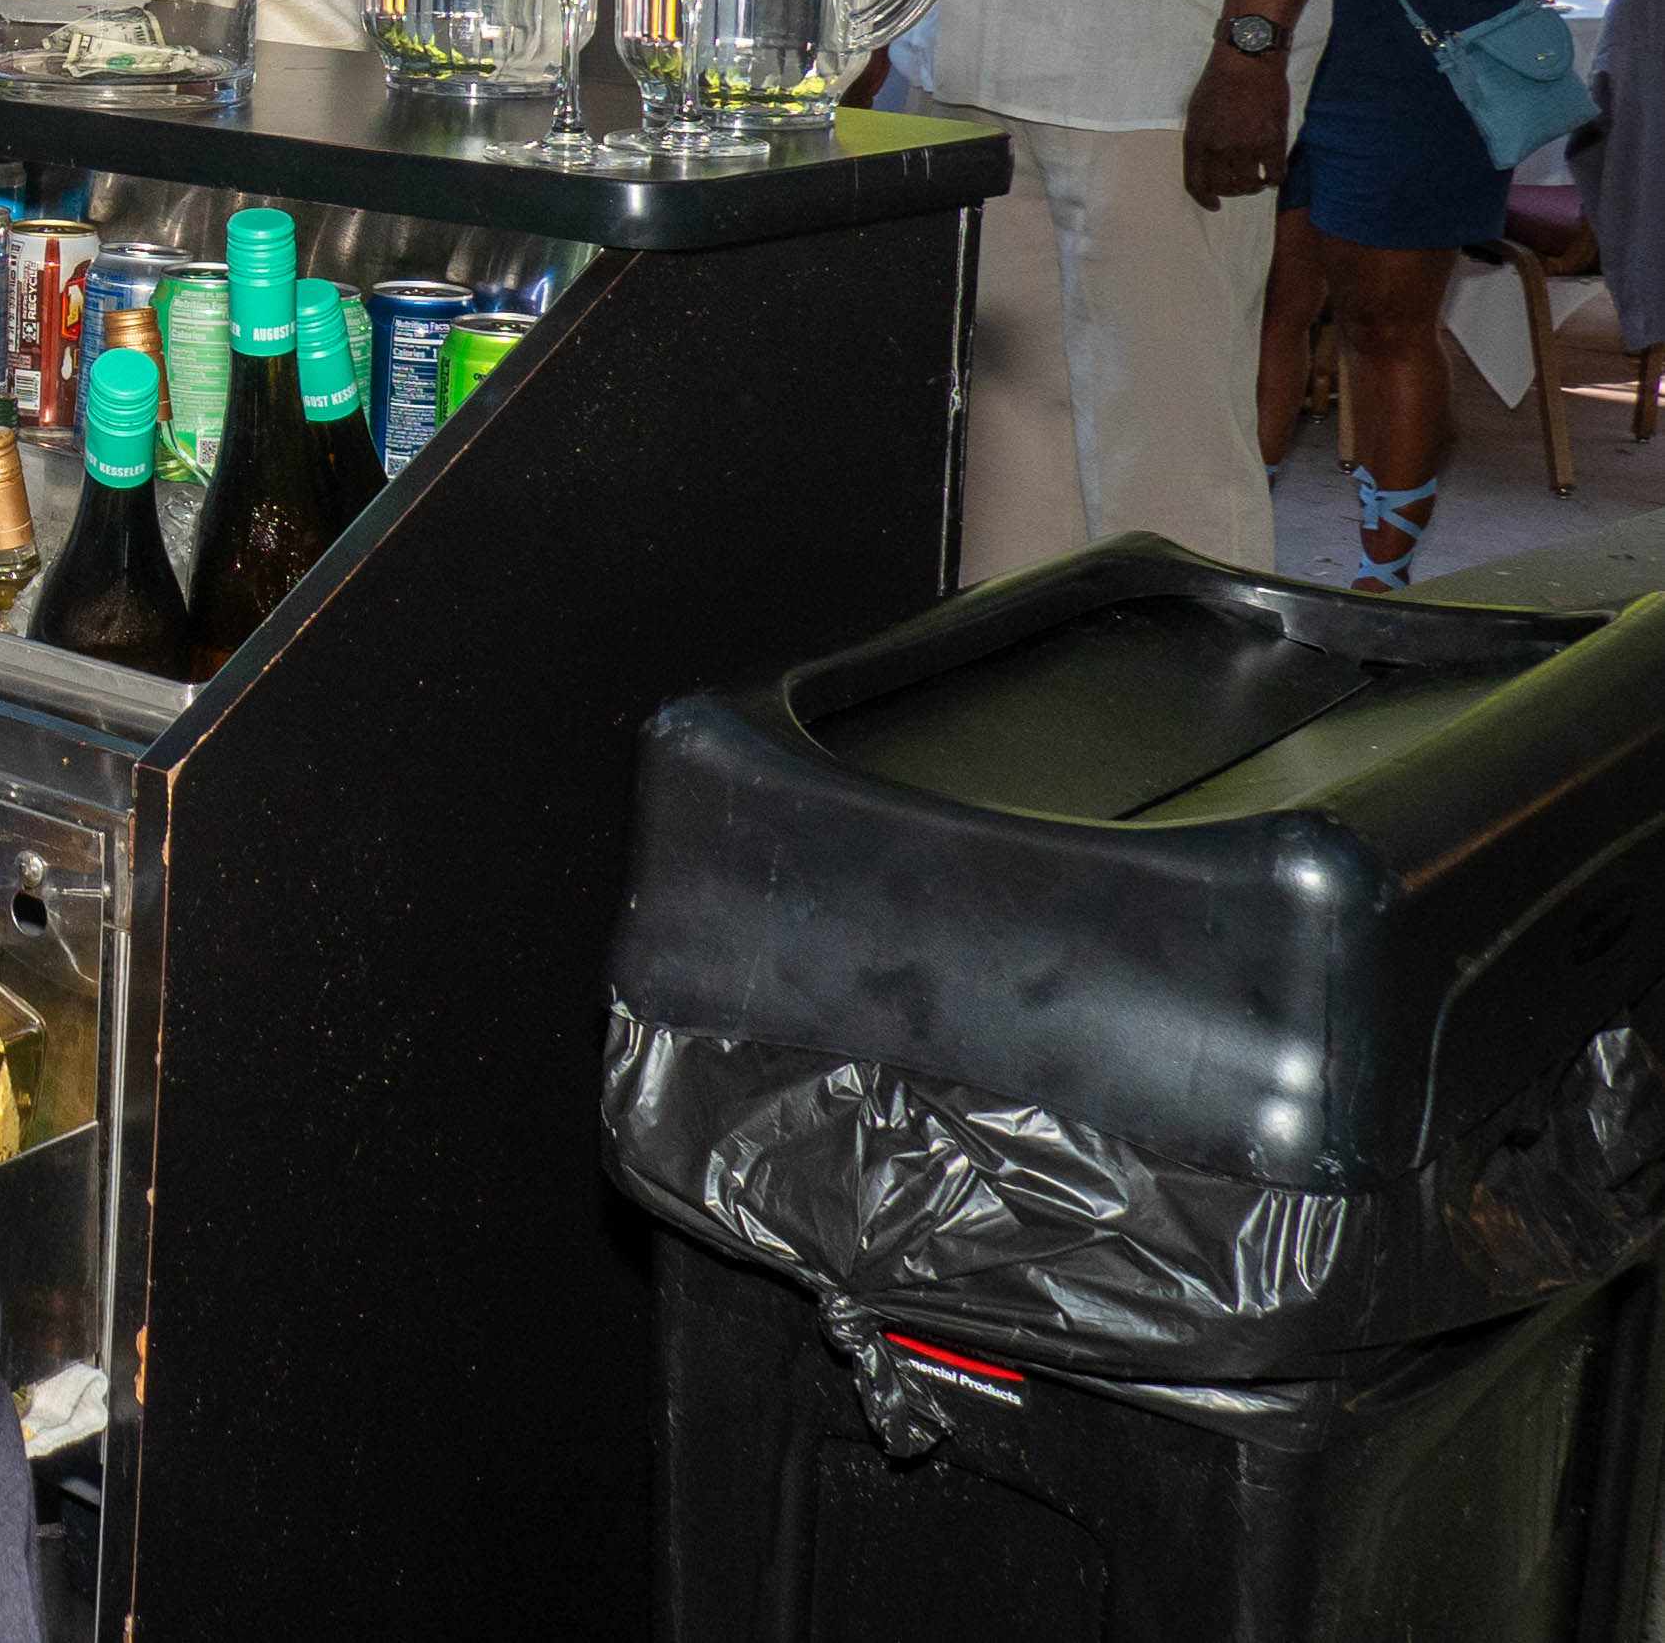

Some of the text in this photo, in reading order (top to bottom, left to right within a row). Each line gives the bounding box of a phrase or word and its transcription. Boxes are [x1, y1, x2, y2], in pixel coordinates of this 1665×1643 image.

[253, 324, 290, 342] AUGUST
[99, 461, 146, 477] KESSELER
[959, 1374, 1022, 1405] Products
